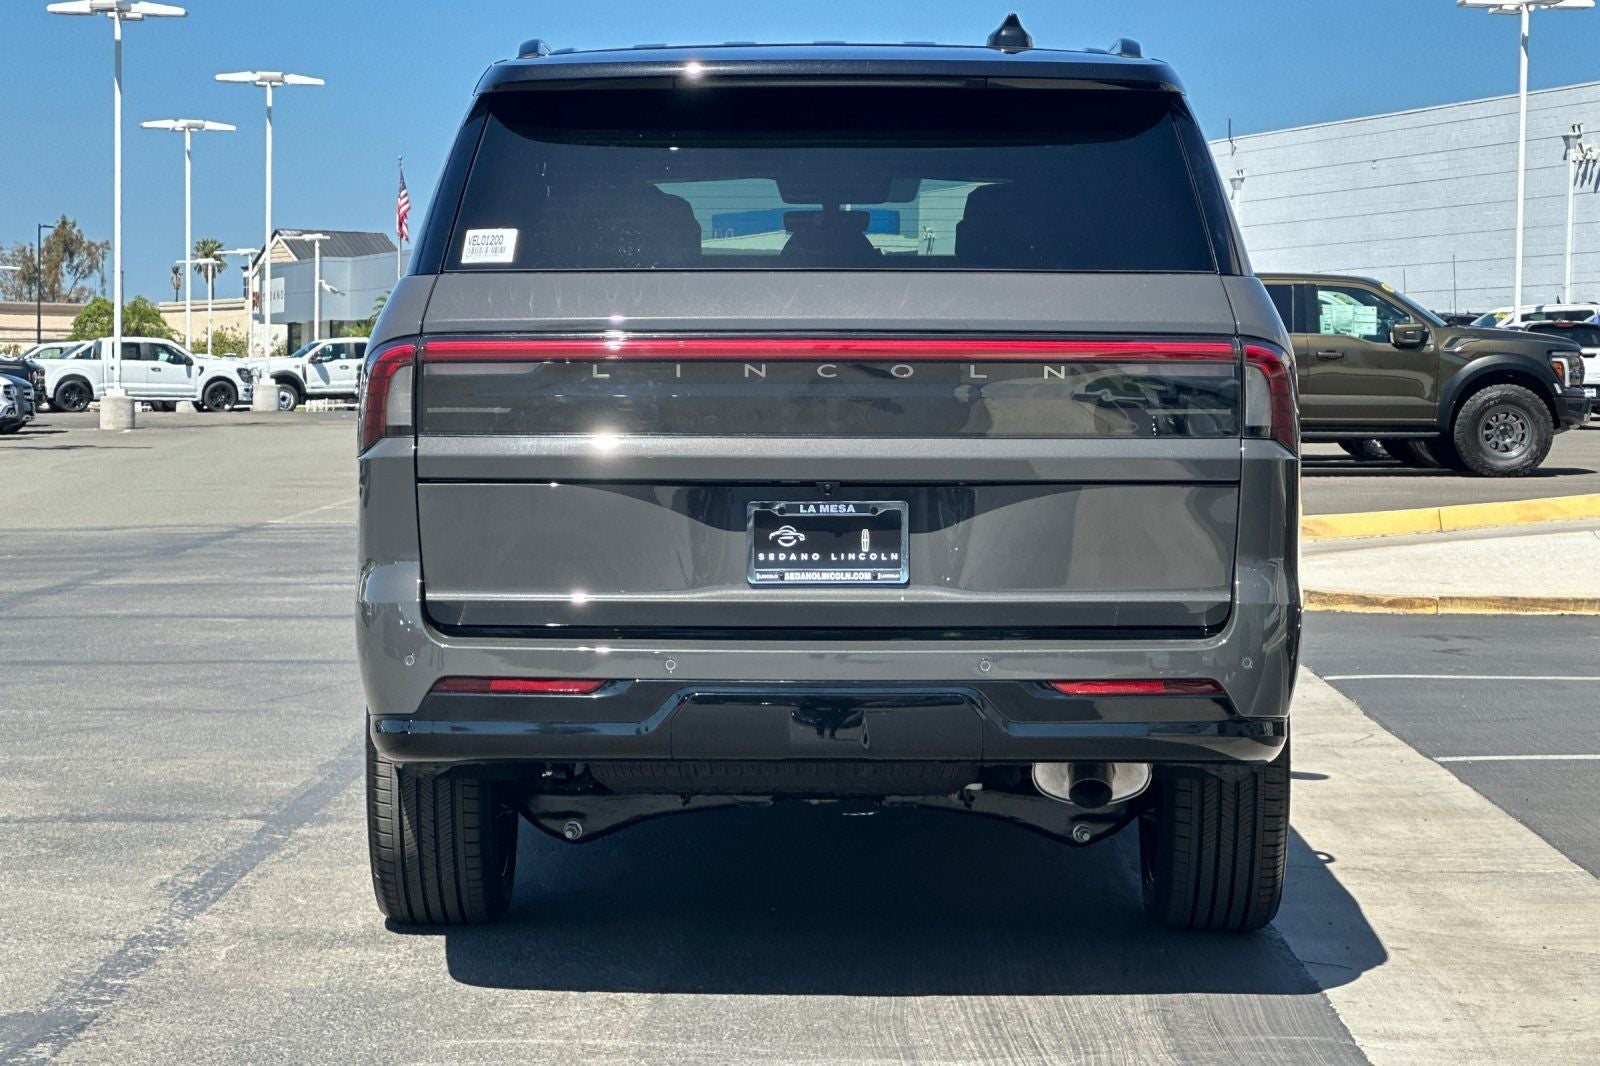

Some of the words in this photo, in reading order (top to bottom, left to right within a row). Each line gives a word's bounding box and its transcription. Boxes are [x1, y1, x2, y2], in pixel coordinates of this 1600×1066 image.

[592, 363, 1066, 380] LINCOLN
[799, 504, 816, 513] LA
[819, 504, 856, 513] MESA
[758, 553, 820, 561] SEDANO
[831, 553, 899, 561] LINCOLN
[784, 572, 872, 581] SEDANOLINCOLN.COM
